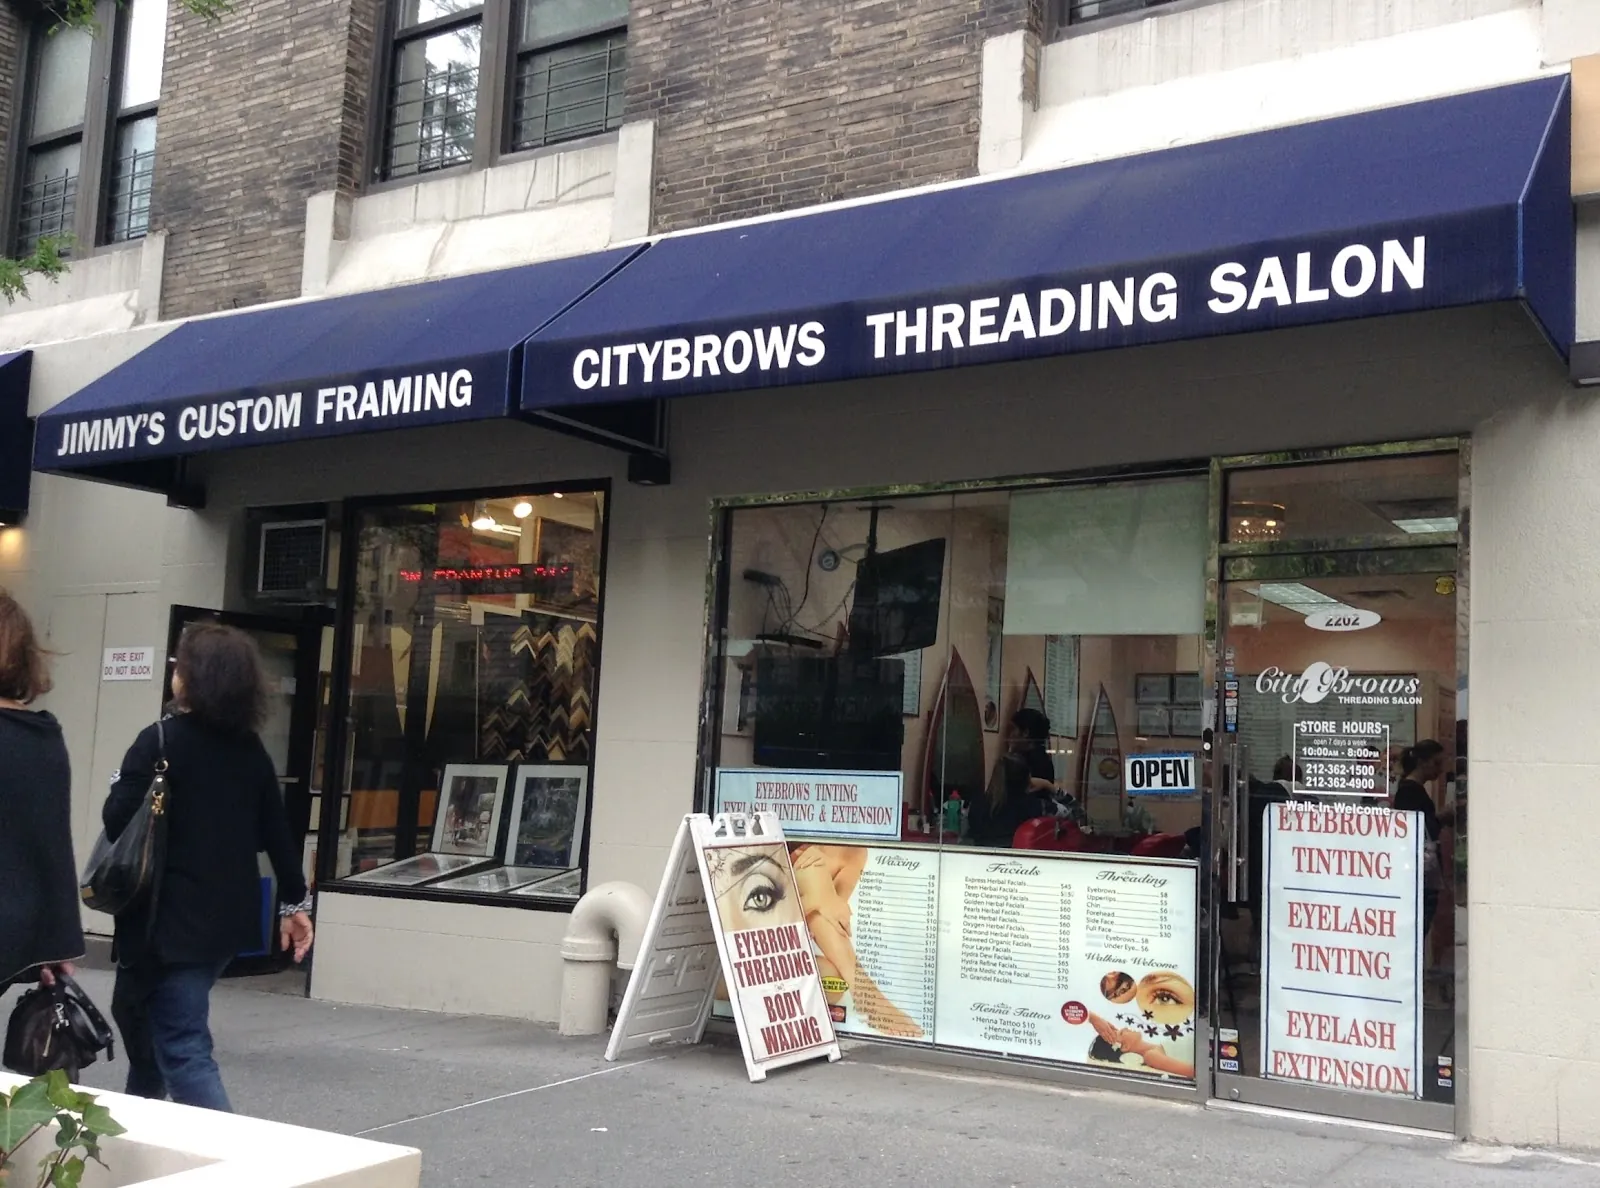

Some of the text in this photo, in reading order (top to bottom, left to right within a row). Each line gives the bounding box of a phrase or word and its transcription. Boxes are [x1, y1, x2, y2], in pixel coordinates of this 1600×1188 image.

[572, 236, 1426, 390] CITYBROWS THREADING SALON
[57, 369, 472, 456] JIMMY'S CUSTOM FRAMING
[1325, 614, 1360, 627] 2202
[112, 652, 144, 662] FIRE EXIT
[104, 666, 151, 675] DO NOT BLOCK
[1255, 665, 1420, 704] City Brows
[1300, 721, 1381, 734] STORE HOURS
[1302, 747, 1338, 756] 10:00AM
[1347, 748, 1379, 757] 8:00PM
[1131, 760, 1189, 788] OPEN
[1306, 764, 1375, 776] 212-362-1500
[755, 782, 858, 802] EYEBROWS TINTING
[1306, 777, 1375, 789] 212-362-4900
[772, 803, 814, 821] TINTING
[818, 805, 826, 822] &
[832, 805, 892, 825] EXTENSION
[1286, 800, 1391, 816] Walk In Welcome
[1277, 805, 1407, 838] EYEBROWS
[875, 855, 920, 871] Waxing
[986, 863, 1041, 876] Facials
[1292, 847, 1392, 880] TINTING
[1096, 871, 1168, 888] Threading
[1087, 886, 1116, 894] Eyebrows
[1288, 902, 1396, 937] EYELASH
[734, 925, 801, 959] EYEBROW
[734, 951, 814, 987] THREADING
[1131, 957, 1178, 969] Welcome
[1292, 943, 1391, 979] TINTING
[763, 990, 805, 1023] BODY
[970, 1002, 1009, 1015] Henna
[1013, 1008, 1051, 1020] Tattoo
[976, 1016, 1035, 1029] Henna Tattoo $10
[989, 1026, 1010, 1034] Henna
[1023, 1029, 1037, 1037] Hair
[1286, 1010, 1396, 1050] EYELASH
[760, 1016, 822, 1055] WAXING
[984, 1033, 1041, 1046] Eyebrow Tint $15
[1272, 1050, 1410, 1095] EXTENSION
